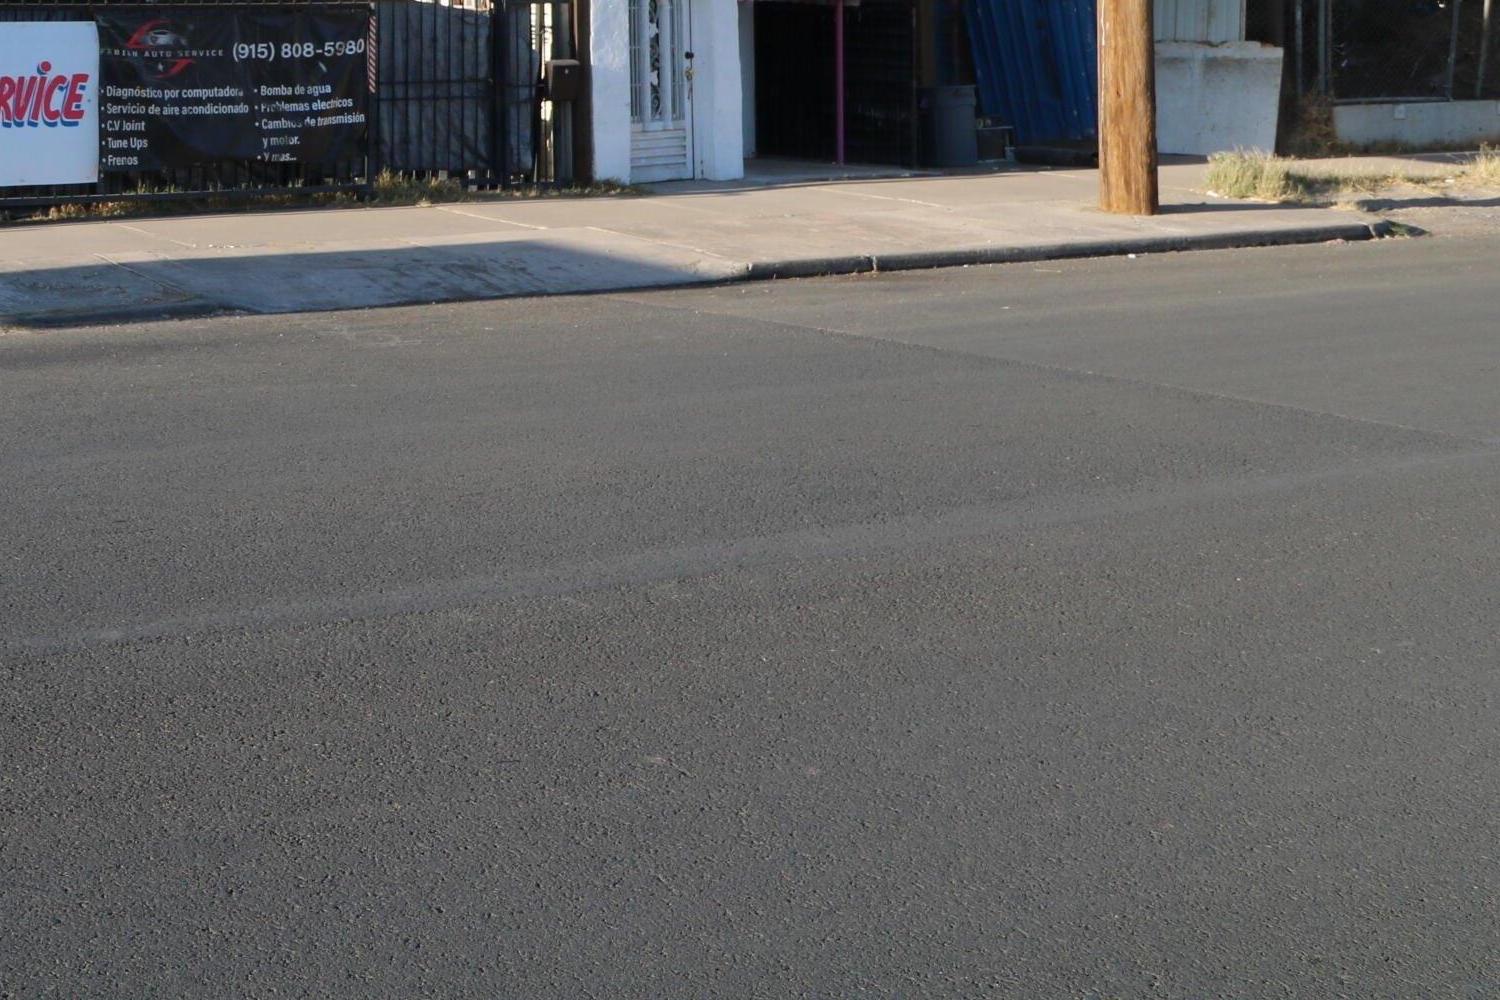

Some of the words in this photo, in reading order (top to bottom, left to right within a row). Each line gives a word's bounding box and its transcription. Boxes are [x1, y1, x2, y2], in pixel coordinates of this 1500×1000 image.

[143, 50, 172, 58] AUTO
[178, 49, 224, 58] SERVICE
[232, 41, 276, 62] (915)
[280, 38, 366, 60] 808-5980
[106, 85, 162, 100] Diagnóstico
[164, 88, 180, 101] por
[181, 85, 244, 100] computadora
[260, 84, 293, 96] Bomba
[294, 84, 306, 95] de
[307, 84, 332, 97] agua
[106, 103, 146, 115] Servicio
[148, 104, 161, 115] de
[162, 103, 180, 115] aire
[181, 102, 249, 115] acondicionado
[261, 101, 310, 113] Problemas
[122, 120, 146, 131] Joint
[261, 117, 302, 129] Cambios
[304, 116, 316, 127] de
[317, 112, 365, 127] transmisión
[107, 137, 128, 149] Tune
[130, 137, 148, 150] Ups
[262, 137, 269, 149] y
[107, 155, 139, 166] Frenos
